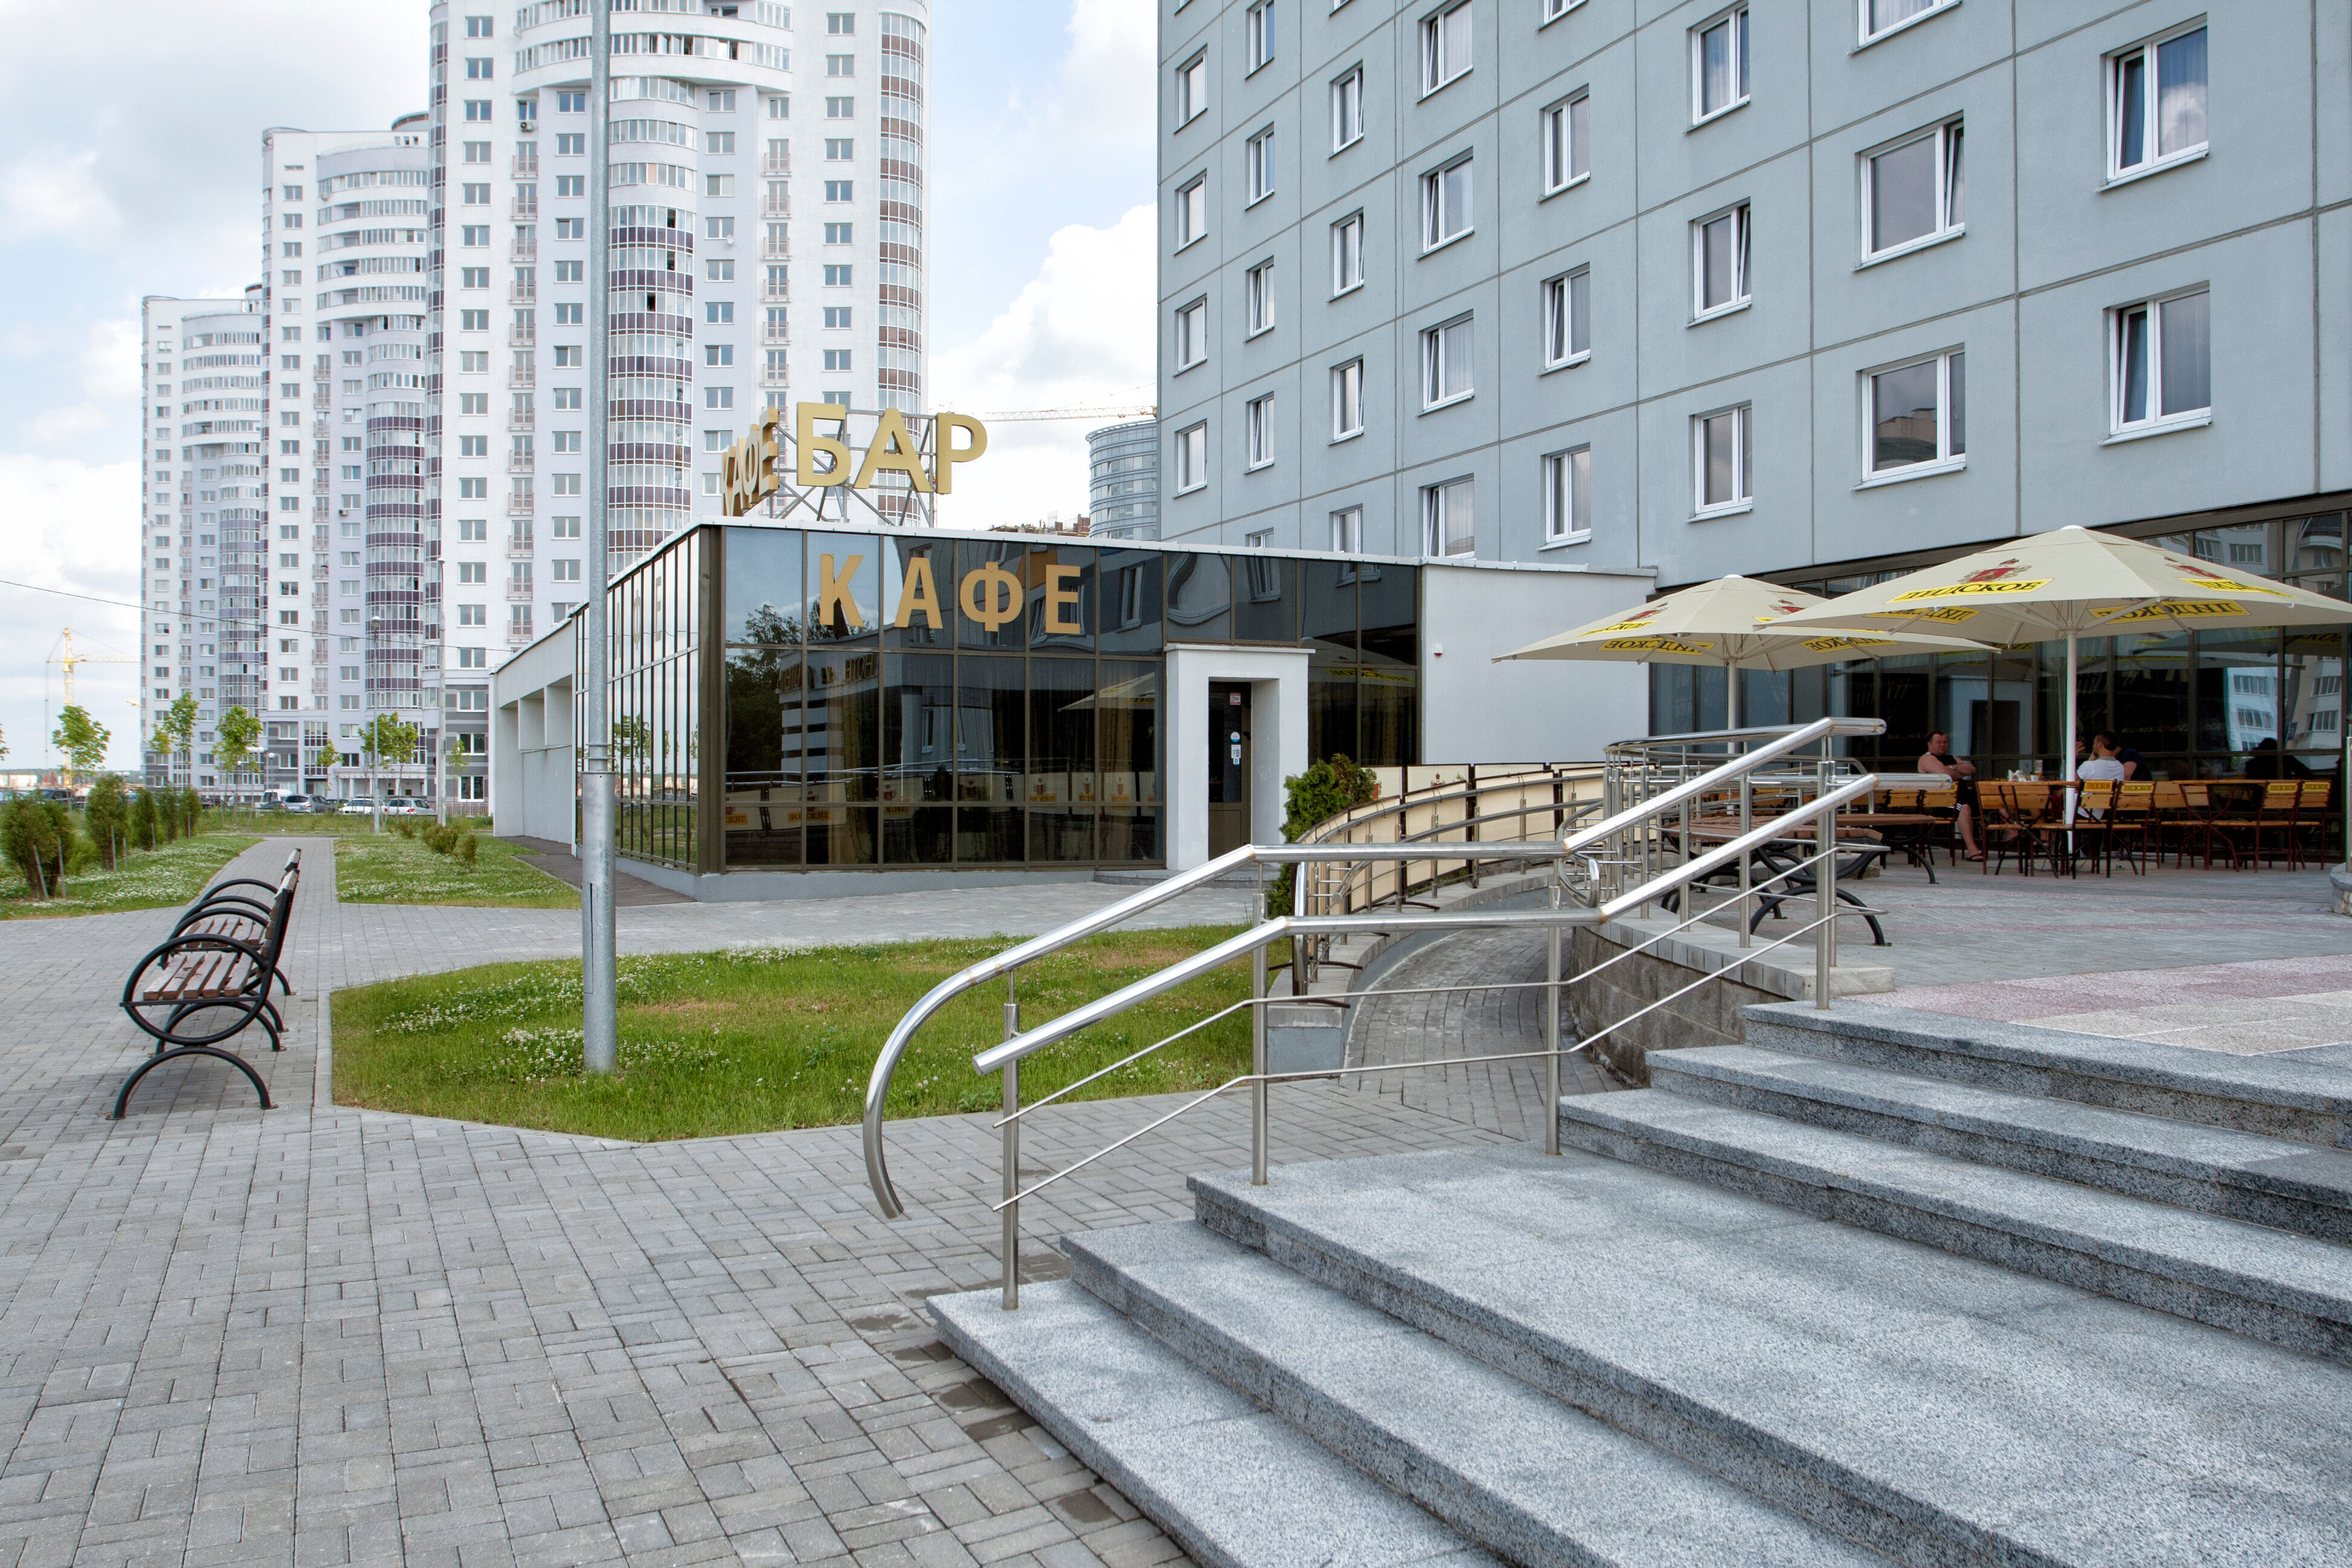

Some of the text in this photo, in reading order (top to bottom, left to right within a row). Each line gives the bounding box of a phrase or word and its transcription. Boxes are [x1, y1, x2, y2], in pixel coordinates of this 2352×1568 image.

[721, 408, 779, 517] КАФЕ
[797, 402, 987, 494] БАР
[615, 576, 662, 661] АФЕ
[819, 553, 1080, 634] КАФЕ
[1893, 581, 2042, 601] ЛИДСКОЕ
